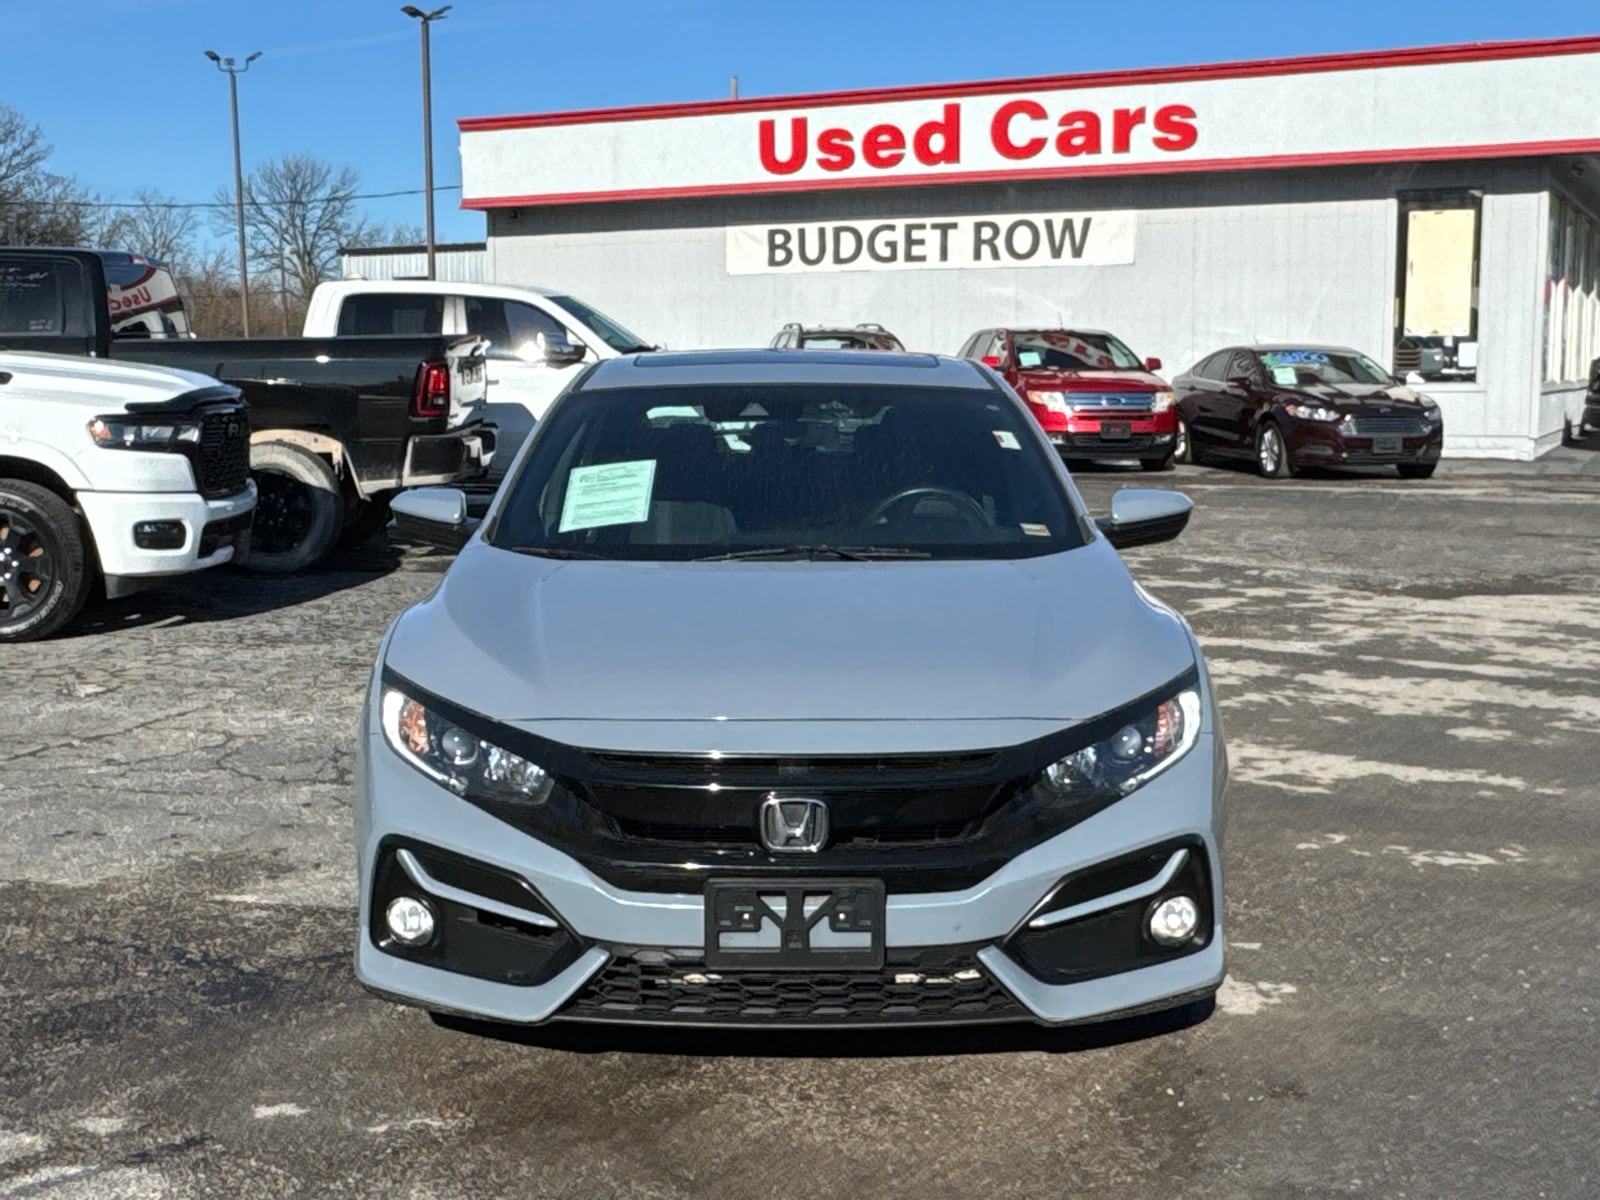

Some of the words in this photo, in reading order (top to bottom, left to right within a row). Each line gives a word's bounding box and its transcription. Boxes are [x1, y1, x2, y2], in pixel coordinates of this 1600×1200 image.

[759, 103, 961, 175] Used
[990, 99, 1198, 160] Cars
[767, 222, 958, 267] BUDGET
[973, 217, 1092, 261] ROW
